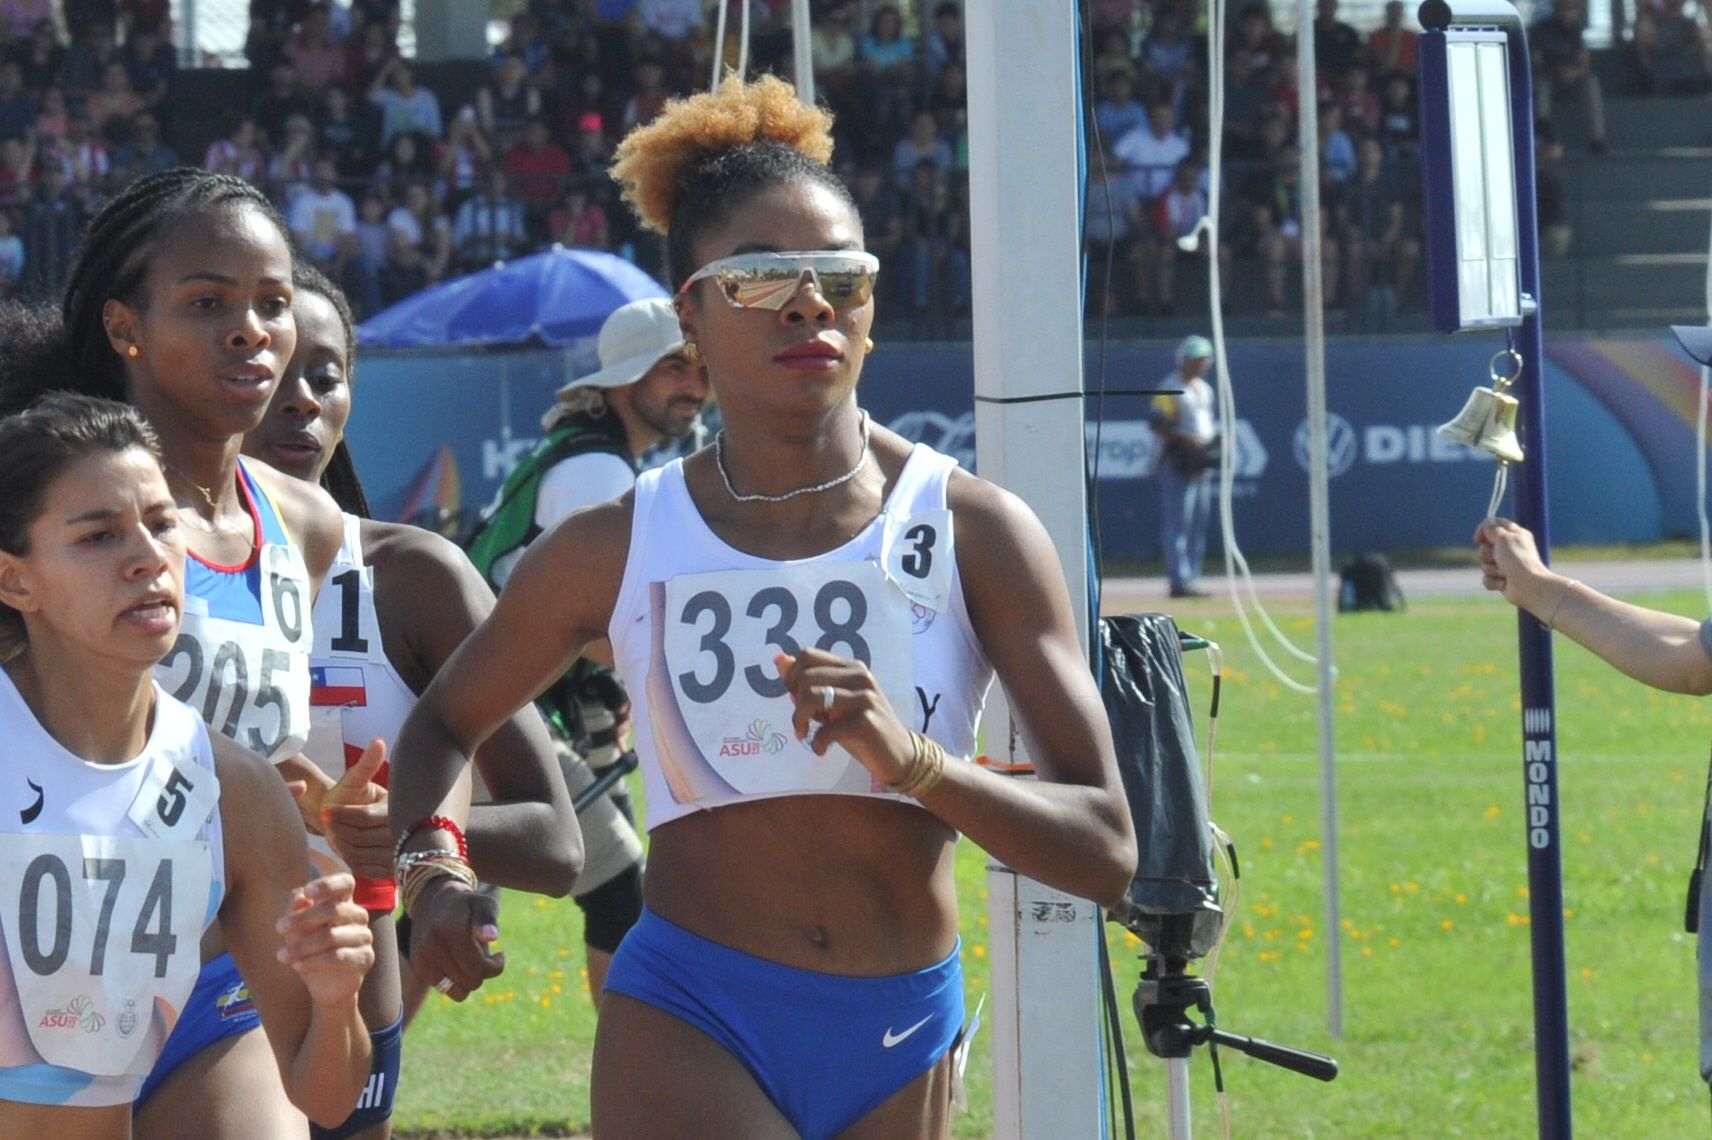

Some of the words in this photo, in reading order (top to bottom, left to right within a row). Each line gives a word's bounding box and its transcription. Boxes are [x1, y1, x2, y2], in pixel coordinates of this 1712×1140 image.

[902, 524, 936, 578] 3
[270, 572, 302, 643] 6
[331, 569, 368, 653] 1
[679, 580, 872, 703] 338
[158, 633, 291, 758] 205
[157, 767, 194, 827] 5
[1525, 740, 1551, 849] MONDO
[19, 855, 176, 978] 074
[356, 1072, 385, 1109] HI
